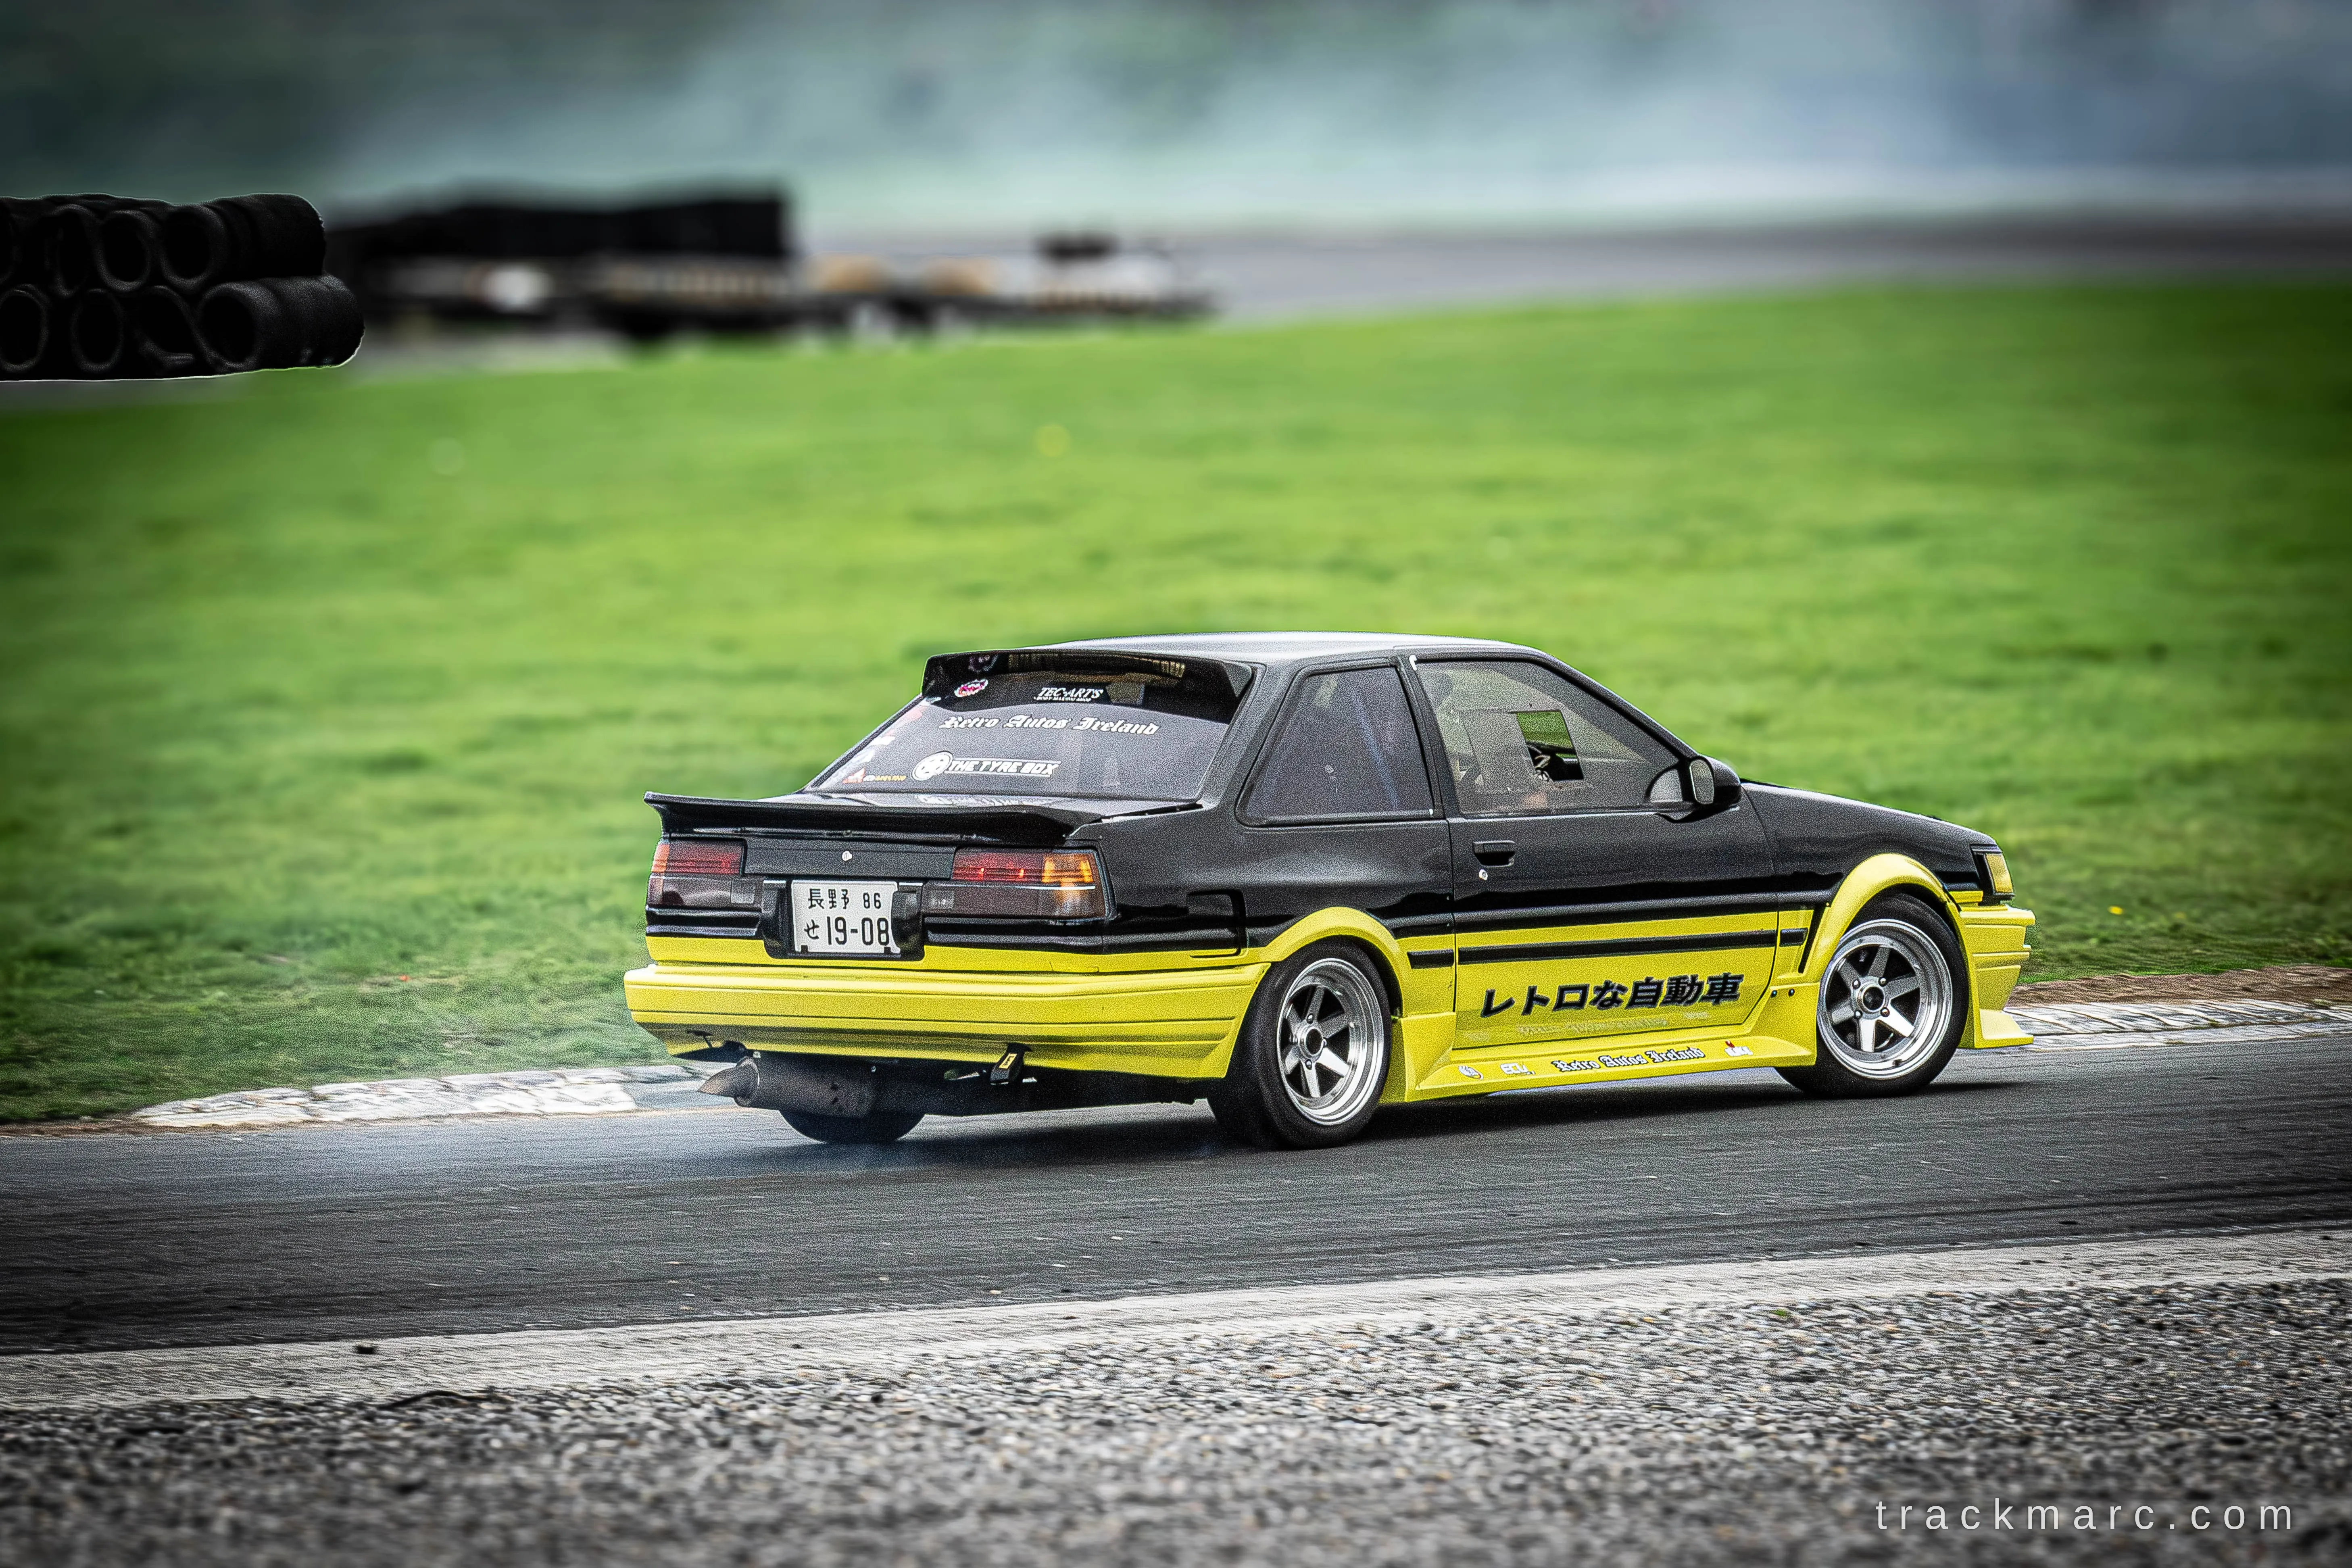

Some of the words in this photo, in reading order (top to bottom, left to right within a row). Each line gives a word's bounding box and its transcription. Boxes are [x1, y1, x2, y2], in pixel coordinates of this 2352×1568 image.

[938, 716, 1000, 729] Retro
[1004, 714, 1071, 729] Autos
[1073, 717, 1159, 735] Ireland
[948, 760, 976, 772] THE
[978, 761, 1022, 773] TYRE
[1020, 762, 1059, 775] BOX
[808, 888, 849, 909] 長野
[863, 892, 881, 909] 86
[804, 919, 820, 940] せ
[827, 916, 889, 946] 19-08
[1480, 972, 1745, 1018] レトロな自動車
[1551, 1060, 1601, 1072] Retro
[1598, 1054, 1647, 1068] Autos
[1645, 1047, 1706, 1063] Ireland
